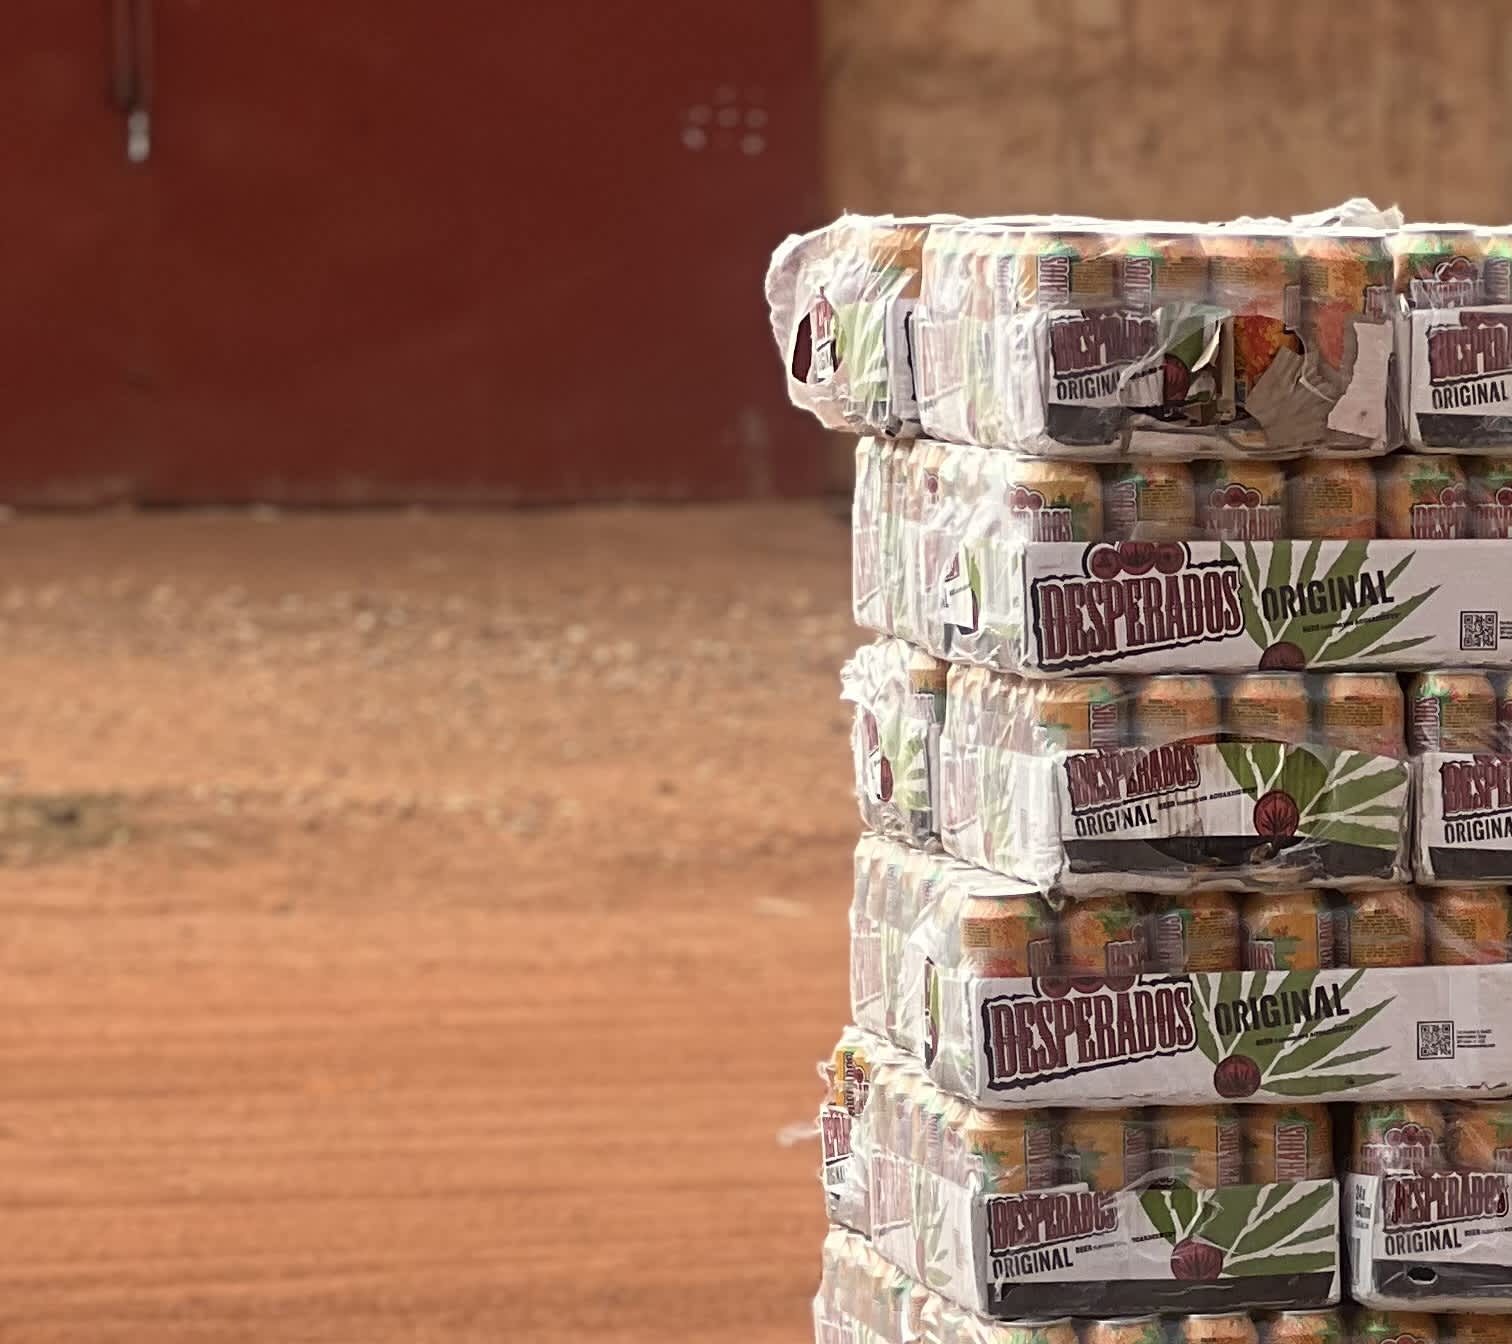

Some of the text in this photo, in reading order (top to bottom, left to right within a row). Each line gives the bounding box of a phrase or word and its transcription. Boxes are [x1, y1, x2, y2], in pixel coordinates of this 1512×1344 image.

[1432, 381, 1508, 409] ORIGINAL
[1041, 567, 1395, 662] DESPERADOS ORIGINAL
[1075, 803, 1158, 838] ORIGINAL
[992, 983, 1350, 1077] DESPERADOS ORIGINAL
[1384, 1228, 1462, 1256] ORIGINAL
[992, 1246, 1074, 1280] ORIGINAL
